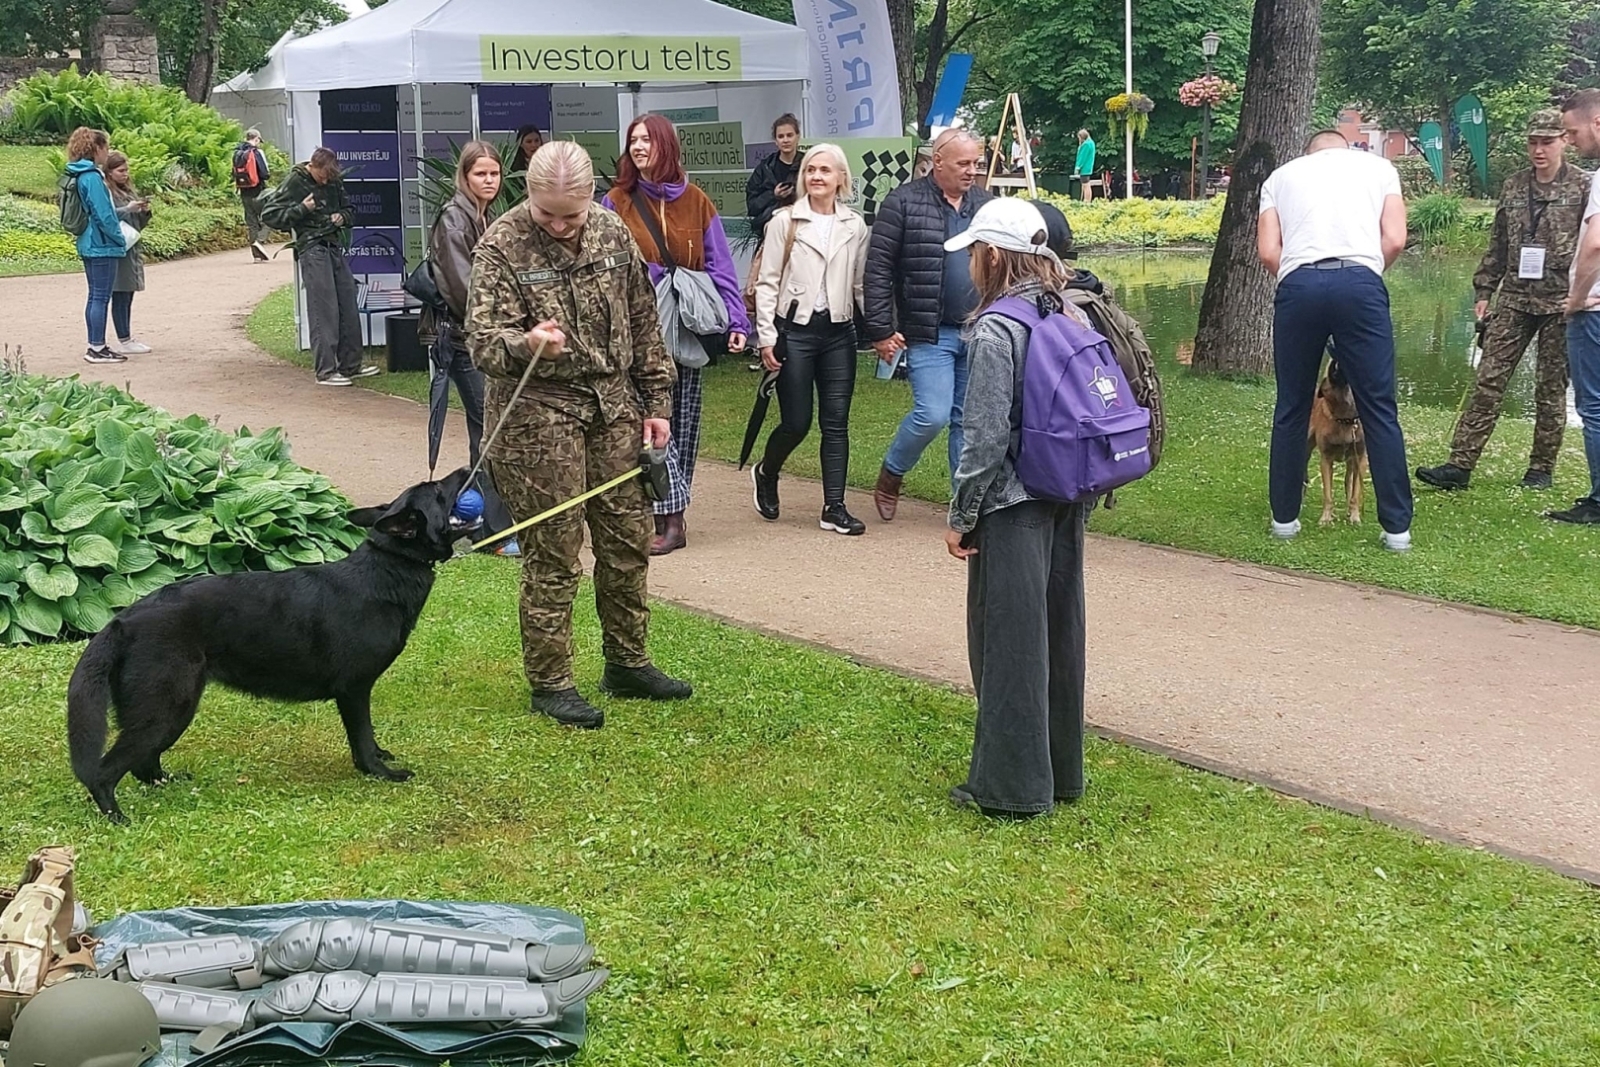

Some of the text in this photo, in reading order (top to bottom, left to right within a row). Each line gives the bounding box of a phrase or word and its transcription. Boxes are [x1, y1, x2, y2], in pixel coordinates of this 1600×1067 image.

[491, 41, 731, 71] Investoru telts
[679, 126, 733, 146] Par naudu
[349, 149, 390, 161] INVESTĒJU
[681, 148, 709, 166] drīkst
[711, 148, 744, 165] runāt.
